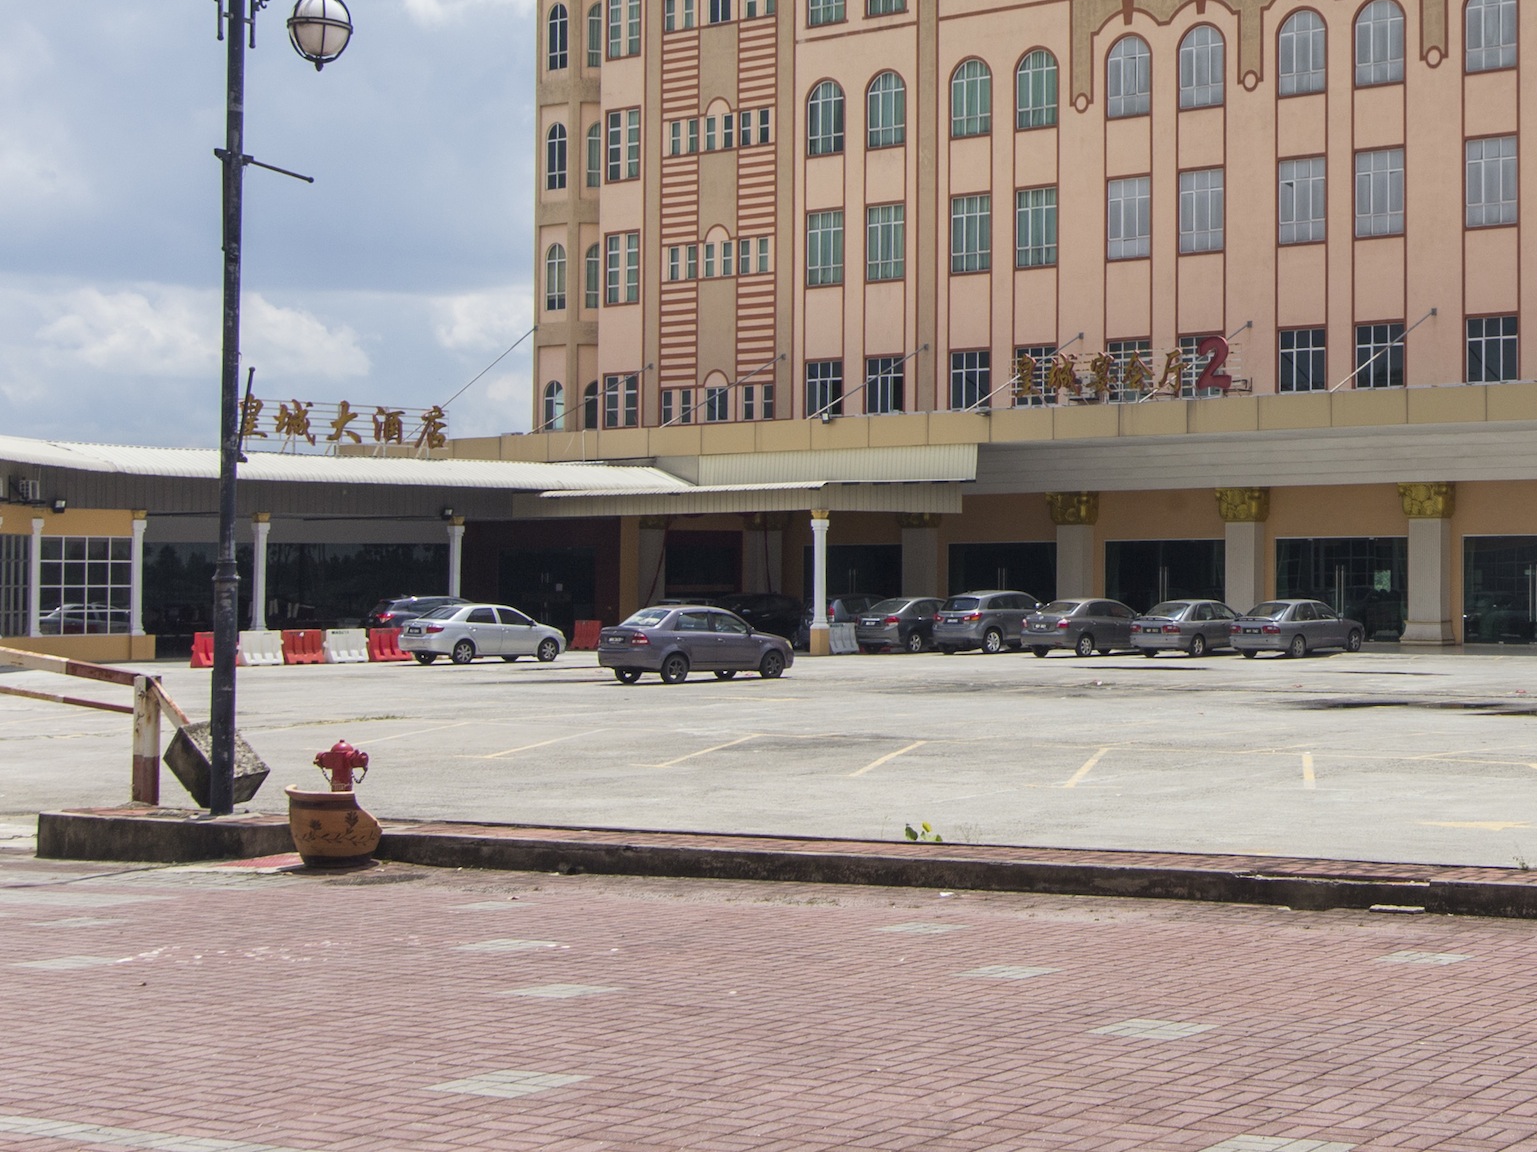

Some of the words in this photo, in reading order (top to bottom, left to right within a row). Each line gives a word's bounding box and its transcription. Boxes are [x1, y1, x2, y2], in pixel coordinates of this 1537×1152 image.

[237, 393, 447, 448] 皇城大酒店
